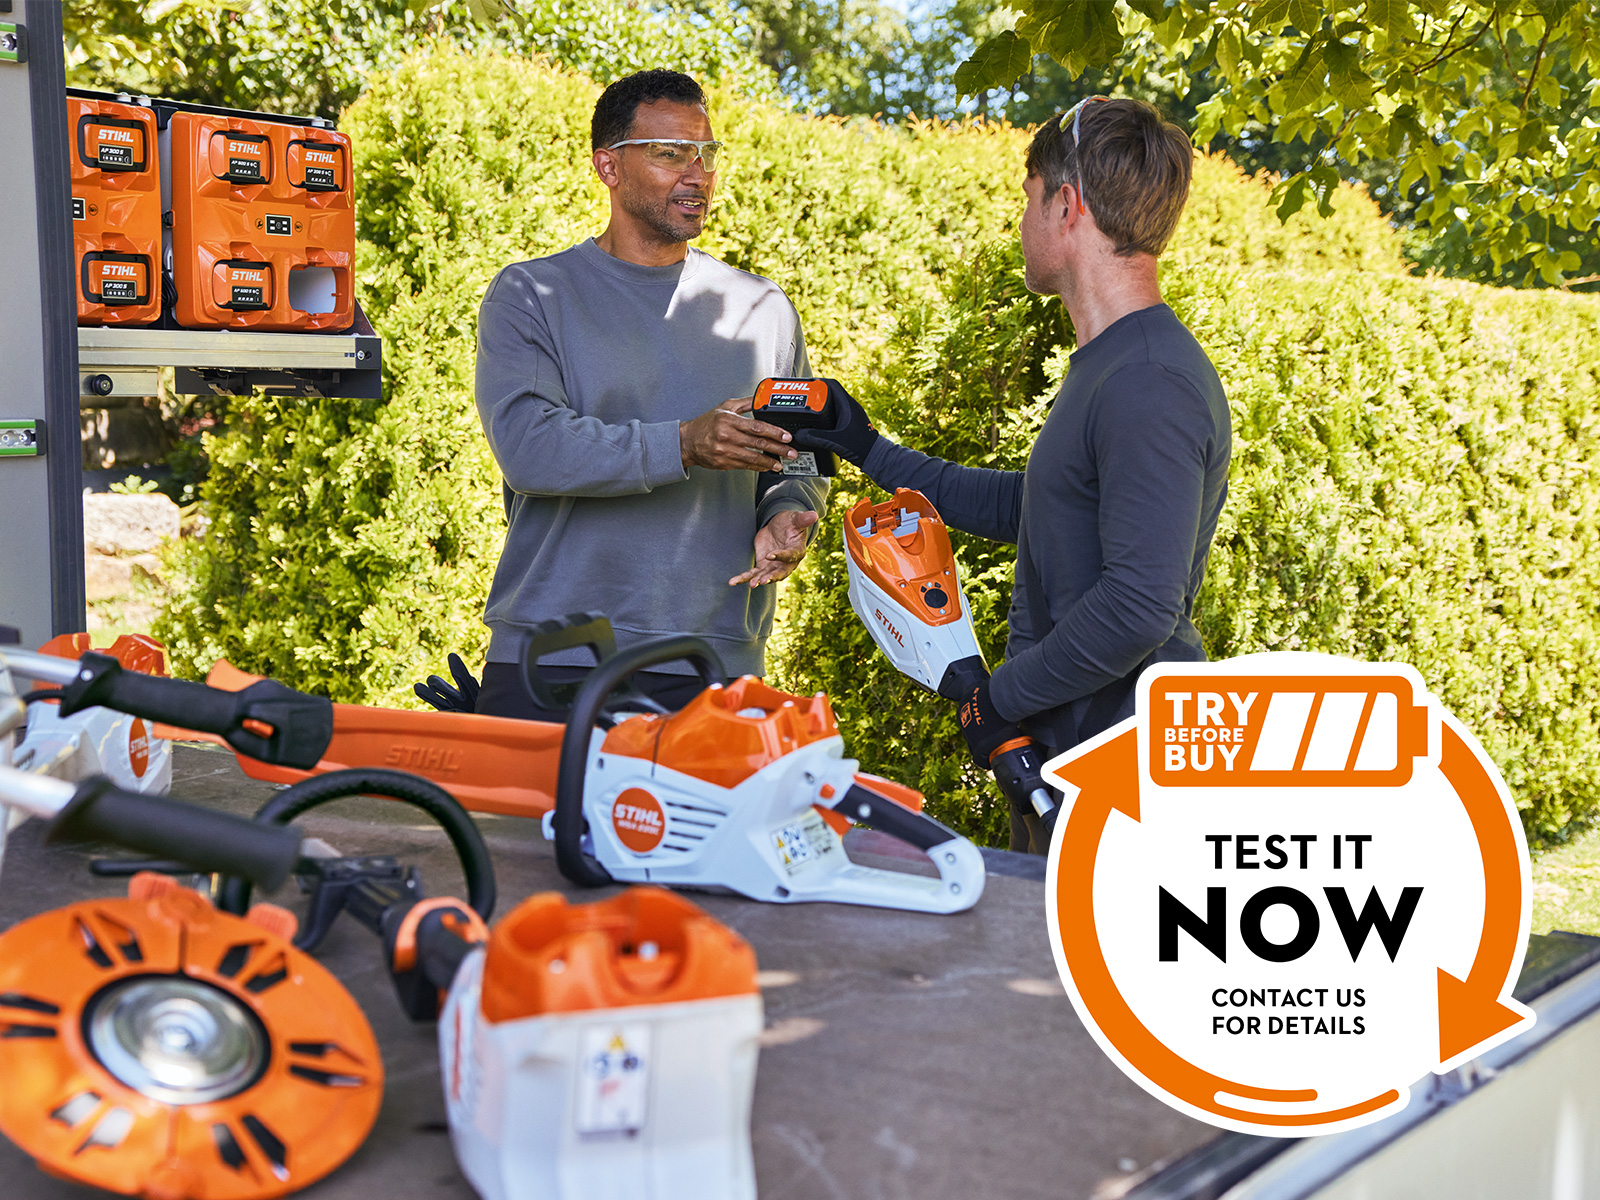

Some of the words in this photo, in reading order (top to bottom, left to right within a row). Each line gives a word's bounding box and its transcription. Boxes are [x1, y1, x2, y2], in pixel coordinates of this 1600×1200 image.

[98, 128, 134, 143] STIHL
[228, 141, 261, 155] STIHL
[305, 151, 336, 164] STIHL
[101, 264, 138, 277] STIHL
[231, 270, 264, 282] STIHL
[772, 382, 811, 391] STIHL
[874, 608, 905, 648] STIHL
[972, 687, 982, 726] STIHL
[384, 744, 460, 772] STIHL
[614, 803, 662, 827] STIHL
